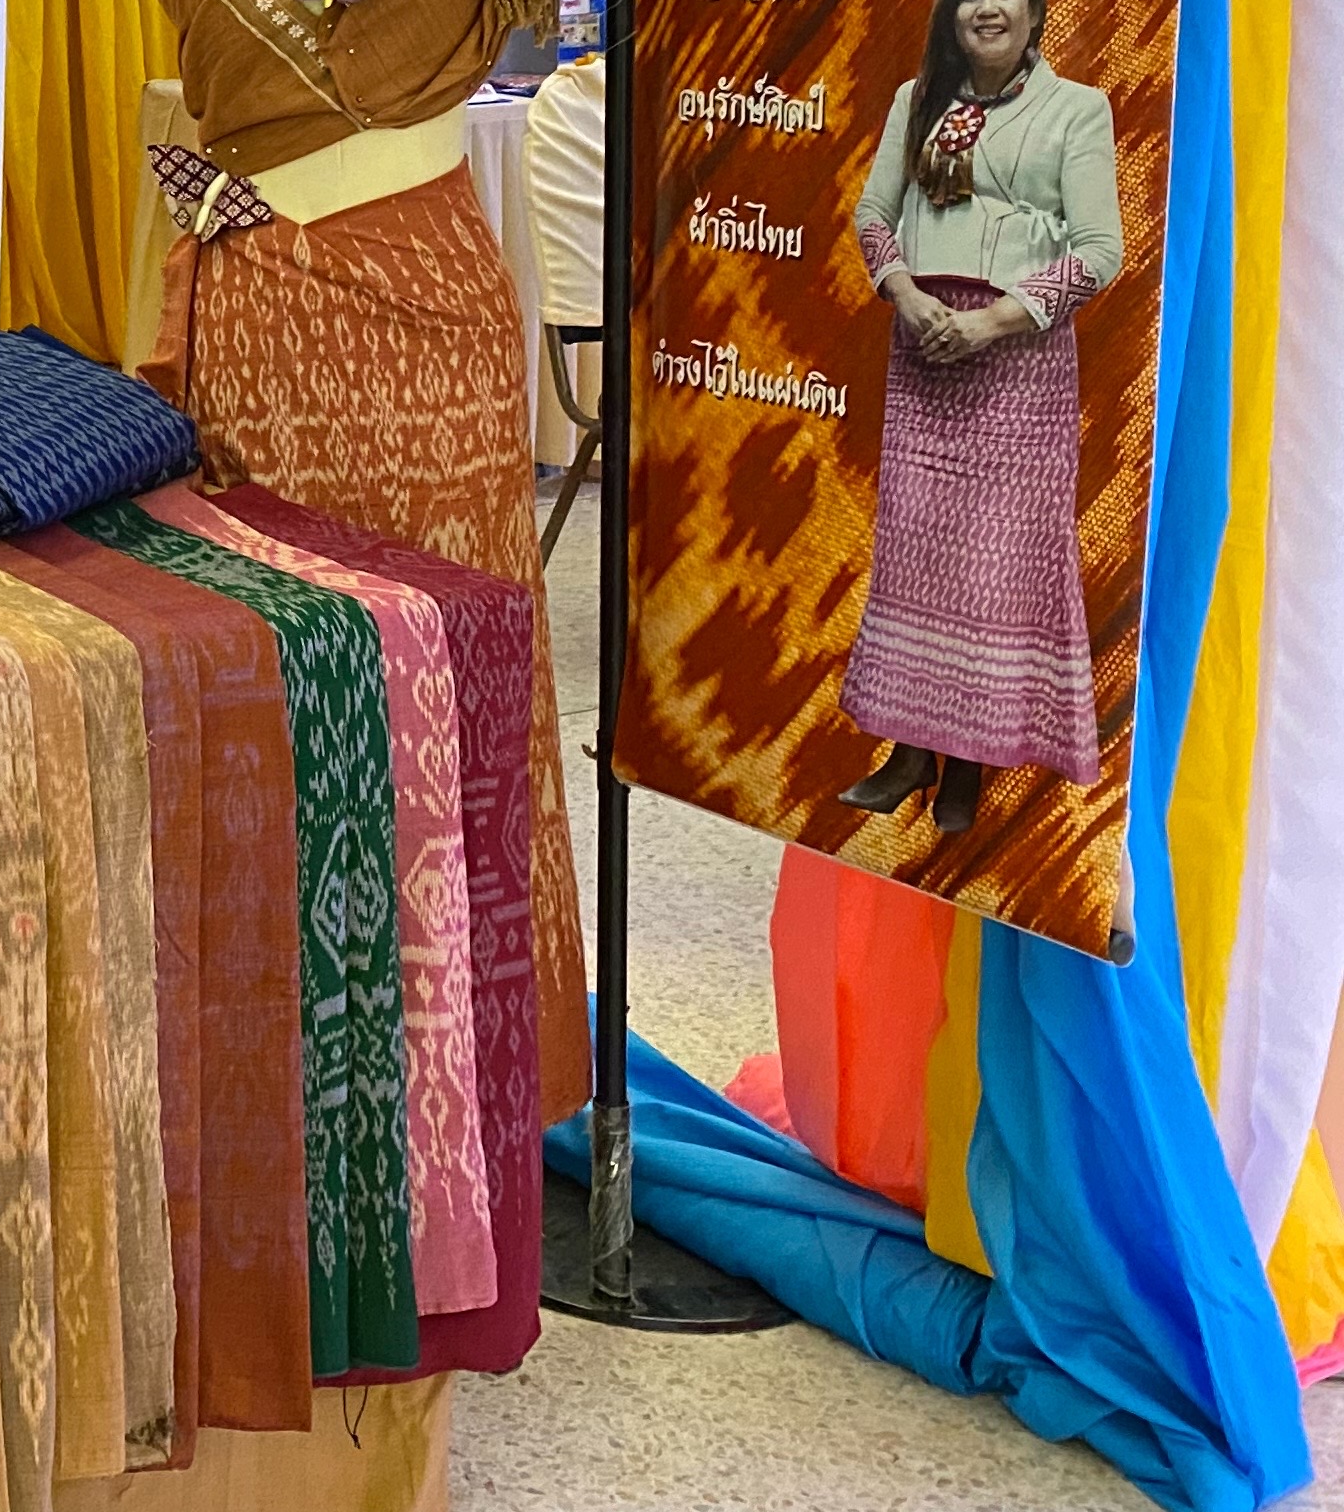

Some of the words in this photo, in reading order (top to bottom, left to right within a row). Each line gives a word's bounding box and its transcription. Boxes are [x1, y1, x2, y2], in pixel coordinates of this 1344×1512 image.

[678, 73, 825, 140] อนุรักษ์ศิลป์
[688, 192, 804, 260] ผ้าถิ่นไทย
[652, 338, 847, 417] ดำรงไว้ในแผ่นดิน
